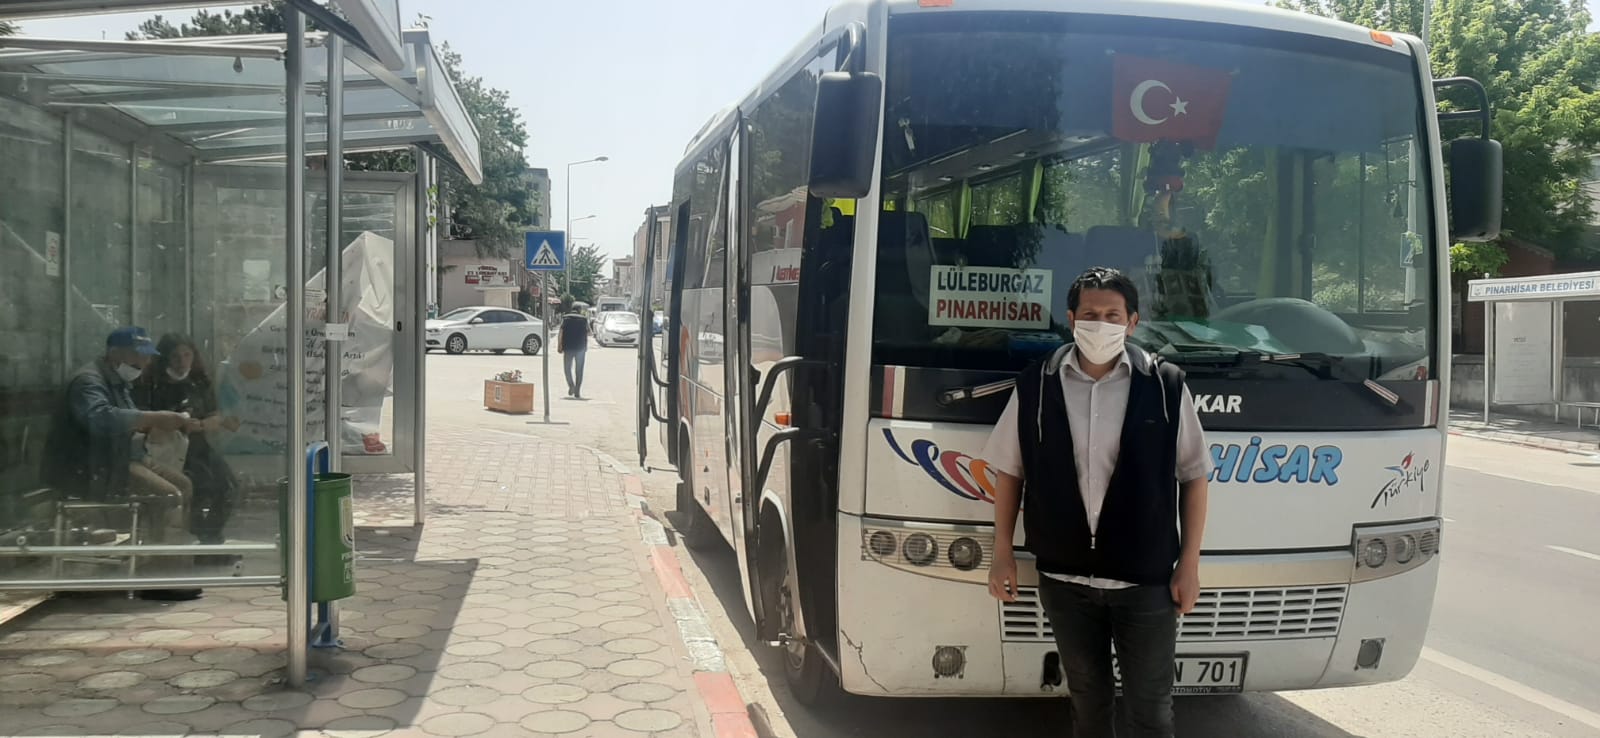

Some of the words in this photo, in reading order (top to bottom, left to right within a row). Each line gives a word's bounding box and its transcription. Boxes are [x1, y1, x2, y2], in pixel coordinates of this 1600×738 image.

[937, 267, 1045, 294] LÜLEBURGAZ
[1485, 283, 1537, 294] PINARHİSAR
[1540, 279, 1595, 291] BELEDİYESİ
[936, 296, 1042, 321] PINARHİSAR
[1193, 394, 1242, 413] KAR
[1207, 436, 1343, 486] HİSAR
[1371, 459, 1430, 509] Türkiye
[1197, 661, 1237, 683] 701
